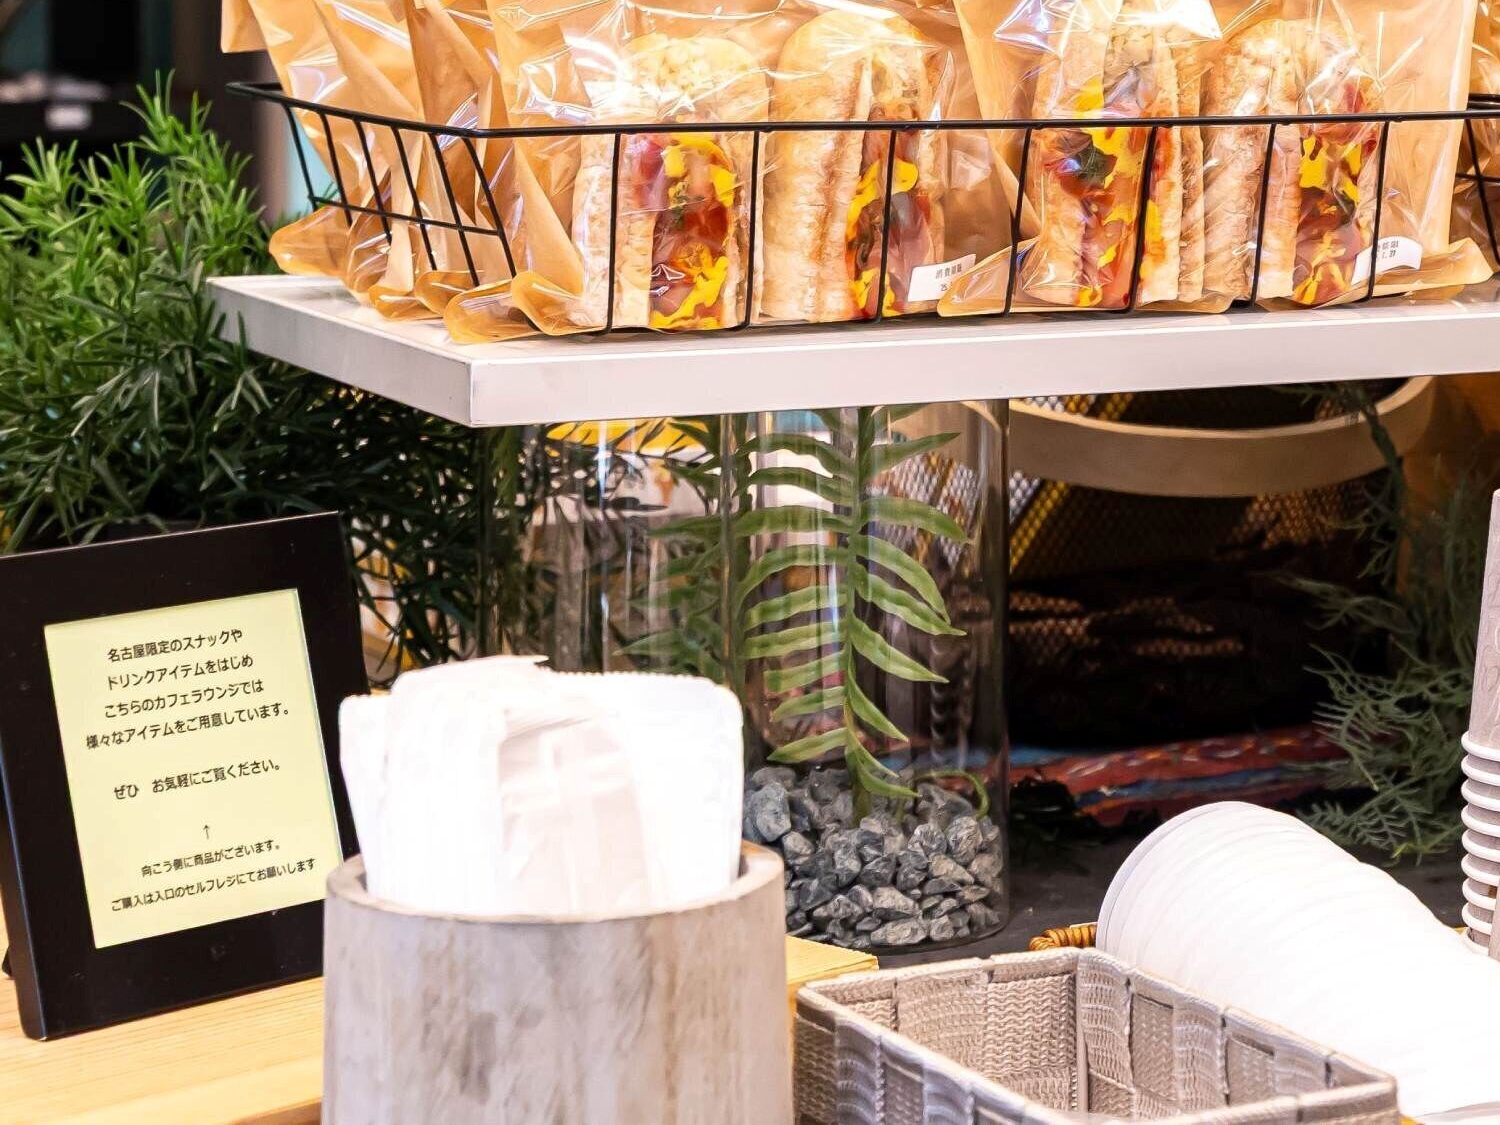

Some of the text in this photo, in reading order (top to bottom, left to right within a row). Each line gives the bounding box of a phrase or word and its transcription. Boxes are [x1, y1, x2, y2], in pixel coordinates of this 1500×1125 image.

[107, 628, 243, 663] 名古屋限定のスナックや
[107, 654, 254, 691] ドリンクアイテムをはじめ
[104, 679, 265, 719] こちらのカフェラウンジでは
[86, 701, 290, 750] 様々なアイテムをご用意しています。
[113, 759, 281, 800] ぜひ お気軽にご覧ください。
[140, 839, 281, 879] 向こう側に商品がございます。
[111, 858, 316, 913] ご購入は入口のセルフレジにてお願いします
